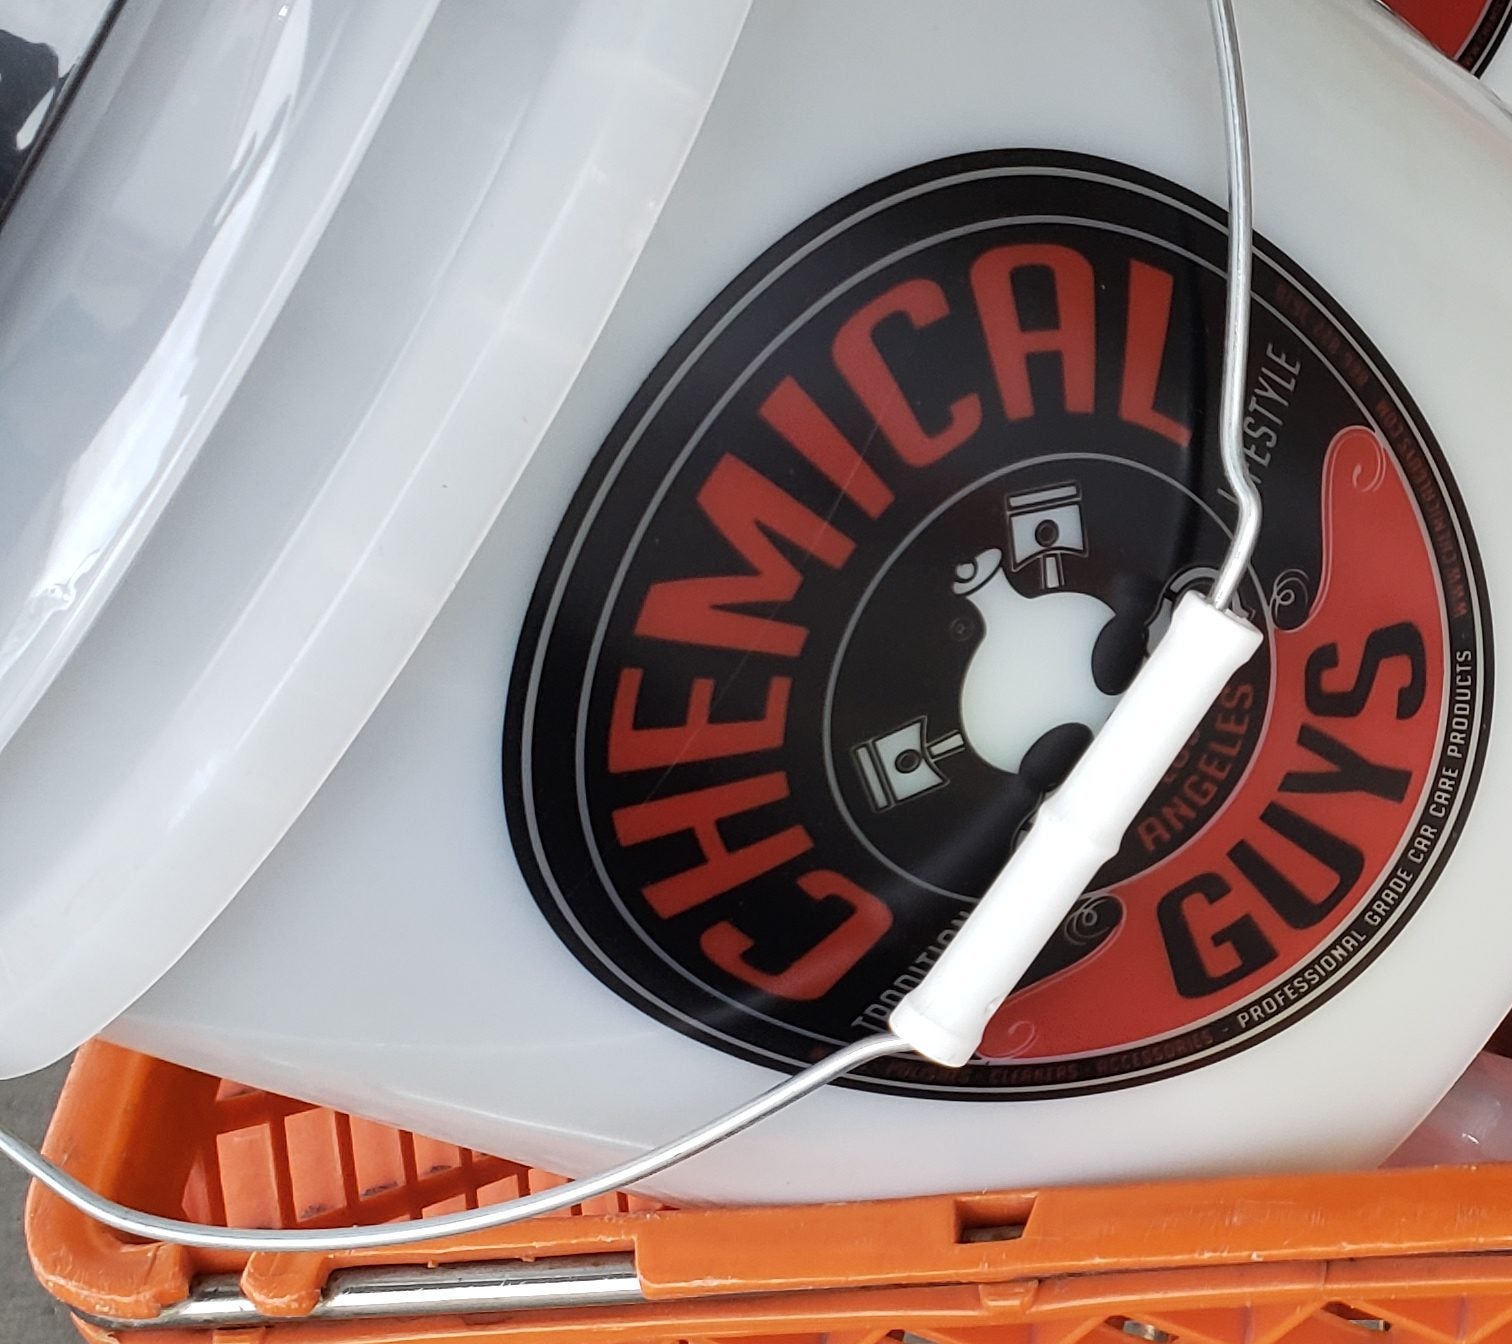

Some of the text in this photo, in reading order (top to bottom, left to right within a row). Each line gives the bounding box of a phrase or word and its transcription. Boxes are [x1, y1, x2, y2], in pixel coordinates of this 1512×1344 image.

[606, 242, 1193, 1002] CHEMICAL
[1137, 683, 1254, 852] ANGELES
[1152, 620, 1428, 1000] GUYS
[1236, 649, 1472, 1029] PROFESSIONAL GRADE CAR CARE PRODUCTS
